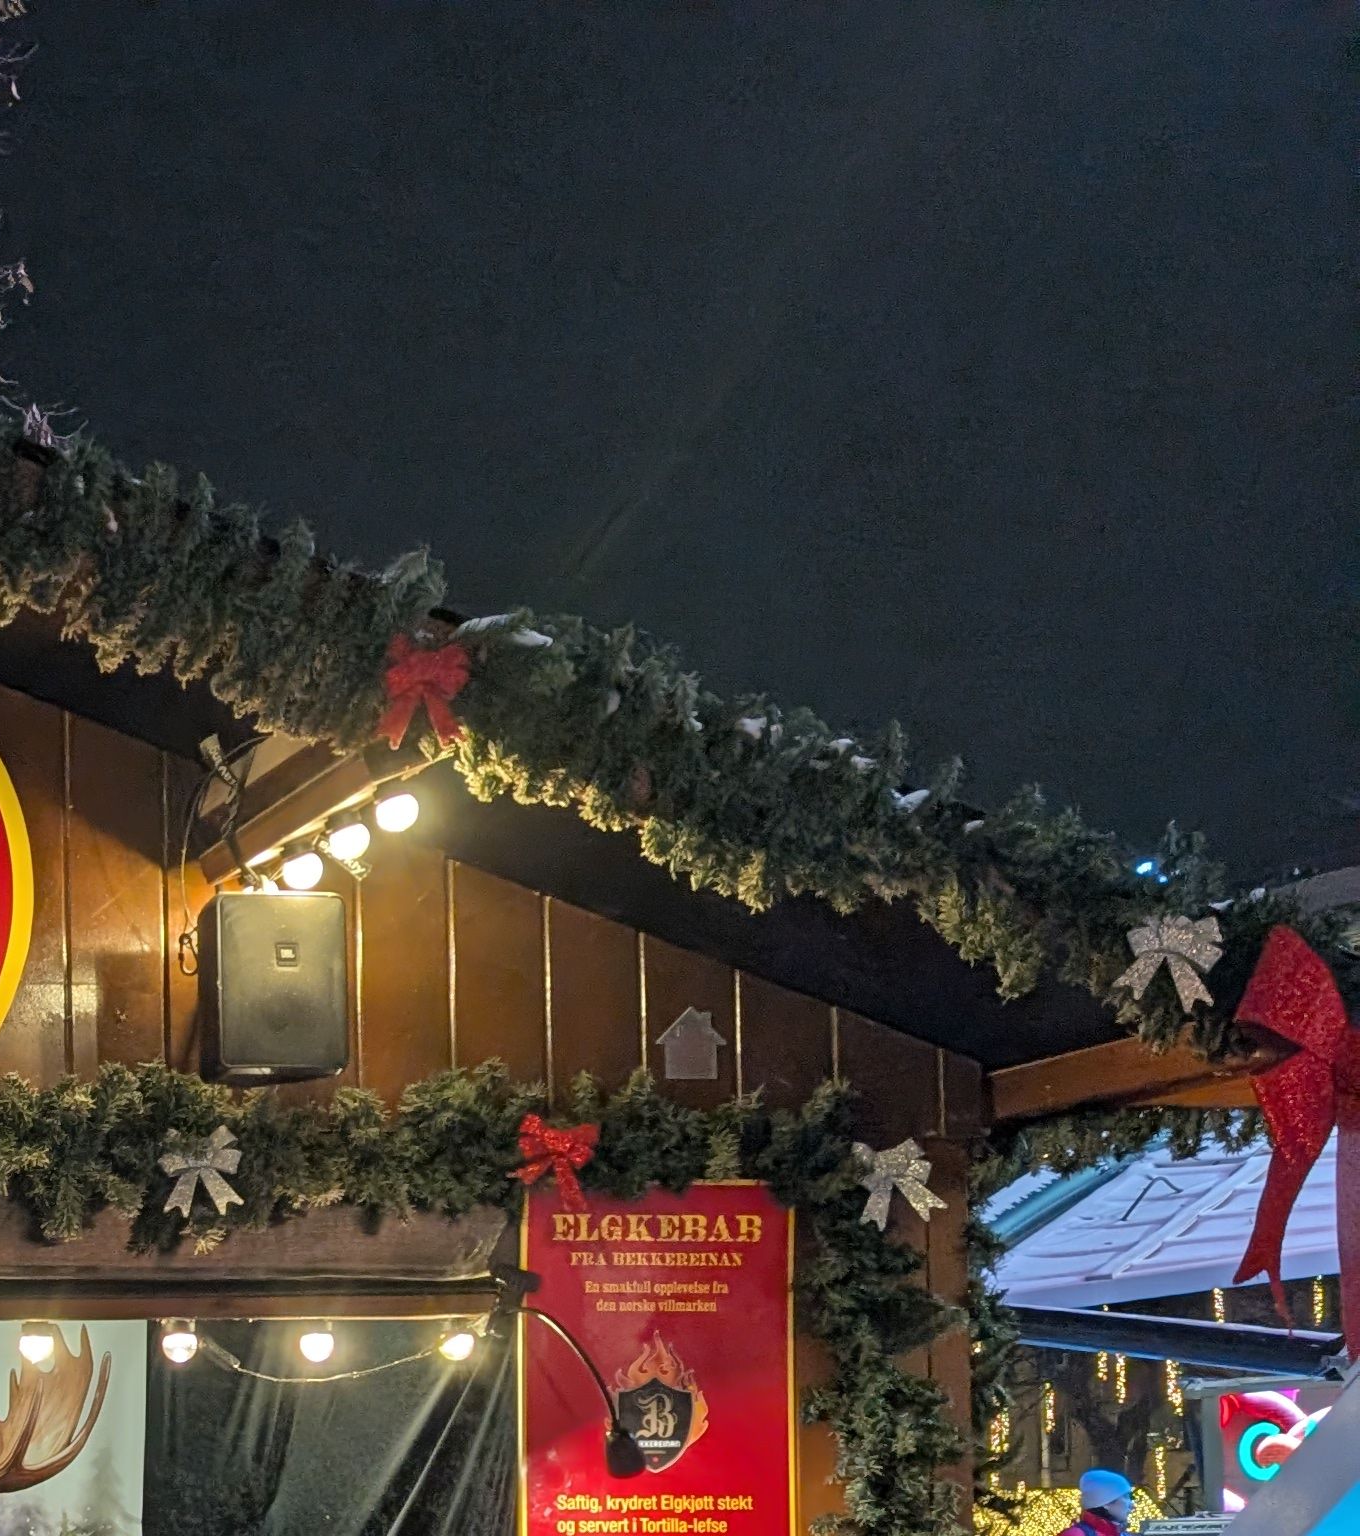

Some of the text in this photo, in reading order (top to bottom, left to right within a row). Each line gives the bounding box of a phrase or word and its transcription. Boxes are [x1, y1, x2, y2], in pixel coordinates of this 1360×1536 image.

[552, 1214, 762, 1243] ELGKEBAB
[570, 1253, 607, 1267] FRA
[556, 1494, 753, 1513] Saftig, krydret Elgkjøtt stekt
[557, 1518, 728, 1535] og servert i Tortilla-lefse
